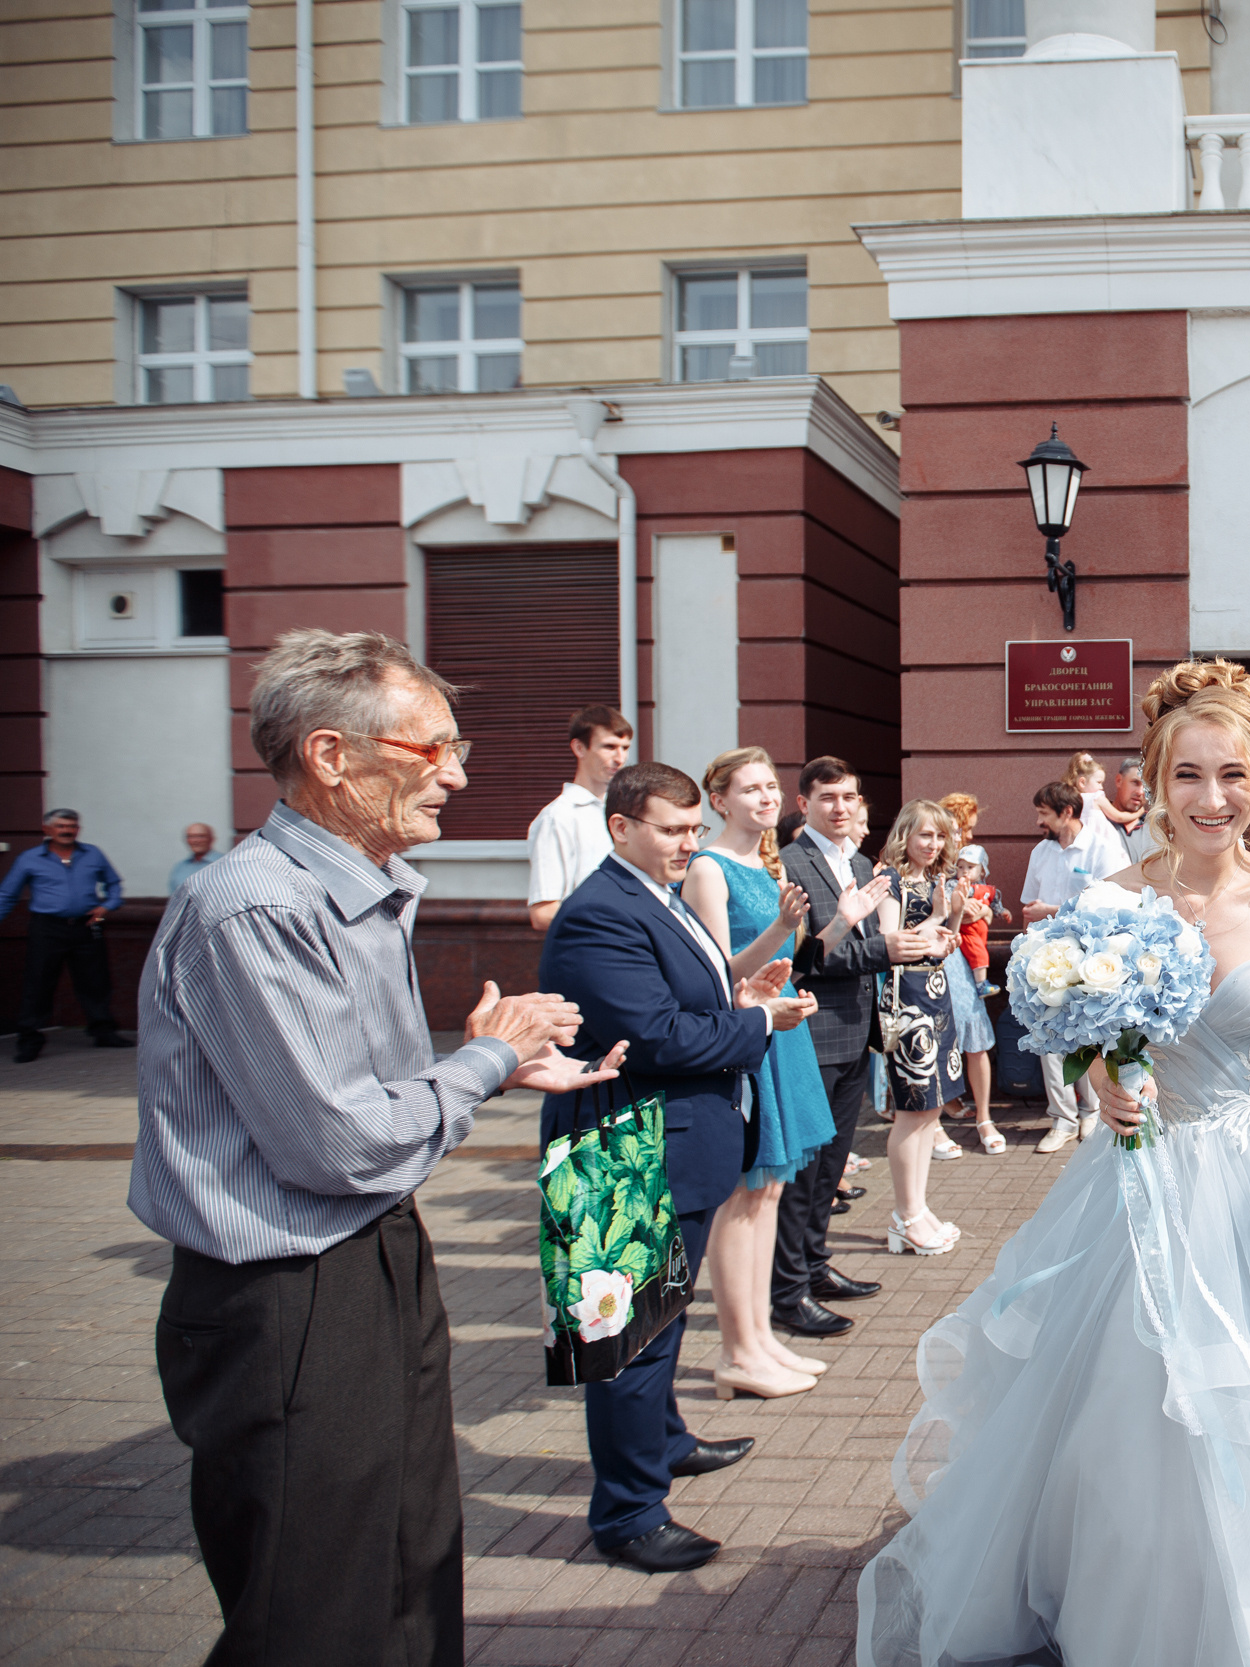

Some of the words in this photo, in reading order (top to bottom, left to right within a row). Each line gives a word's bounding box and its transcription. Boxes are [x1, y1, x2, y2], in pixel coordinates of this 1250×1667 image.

[1049, 667, 1088, 676] ДВОРЕЦ
[1024, 682, 1113, 692] БРАКОСОЧЕТАНИЯ
[1024, 698, 1088, 707] УПРАВЛЕНИЯ
[1090, 697, 1114, 706] ЗАГС
